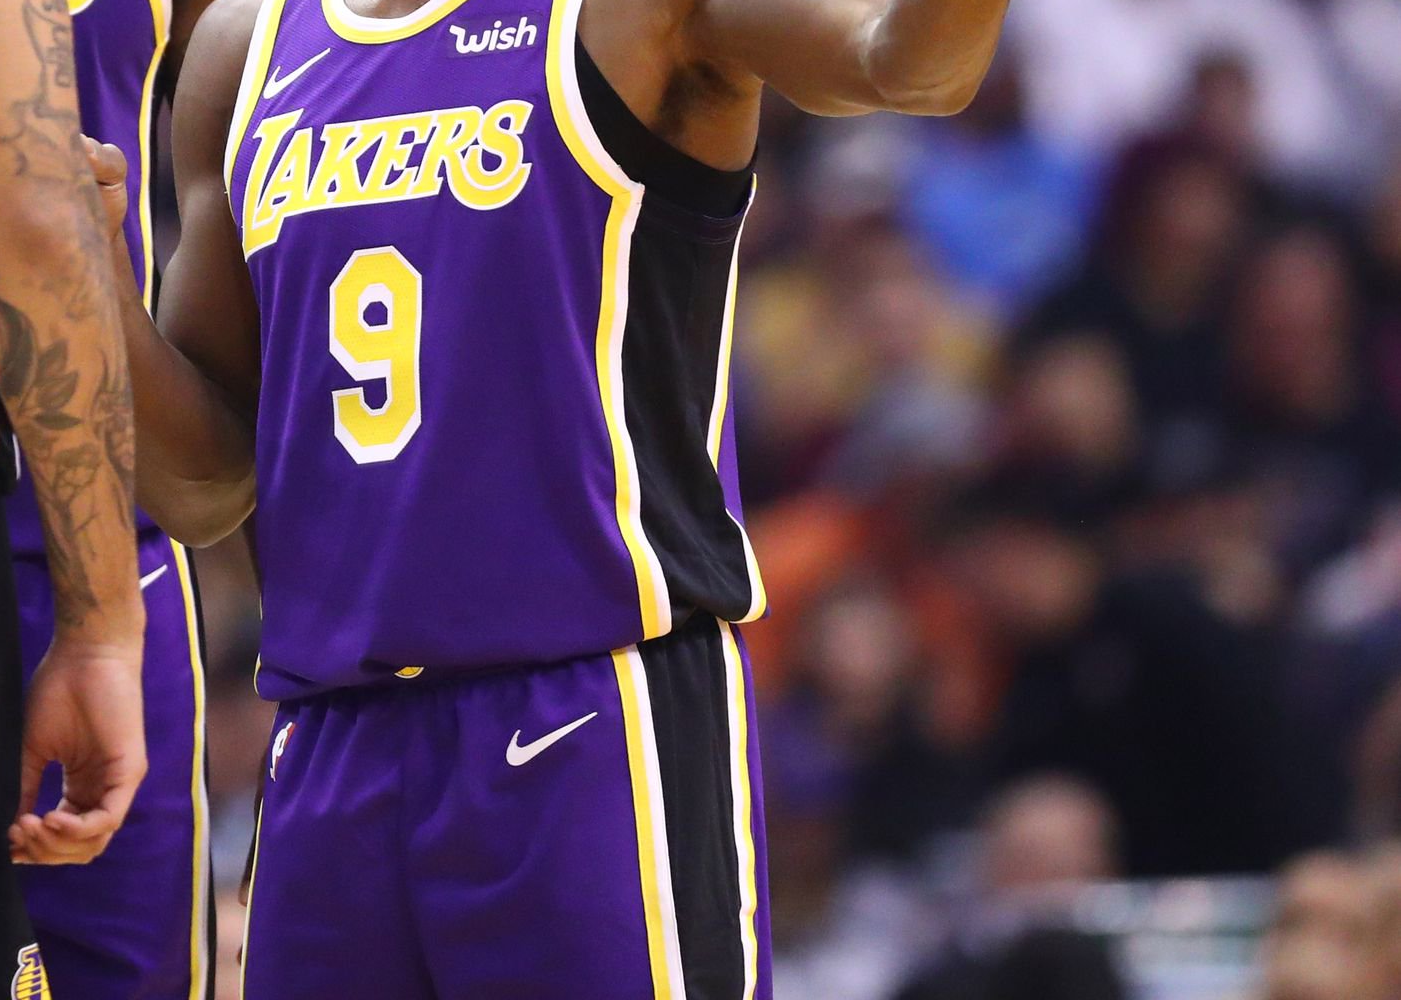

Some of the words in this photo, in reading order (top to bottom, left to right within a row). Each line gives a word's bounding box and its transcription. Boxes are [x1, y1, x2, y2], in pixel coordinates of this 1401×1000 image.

[449, 16, 537, 54] wish
[242, 99, 533, 262] LAKERS
[329, 245, 422, 464] 9
